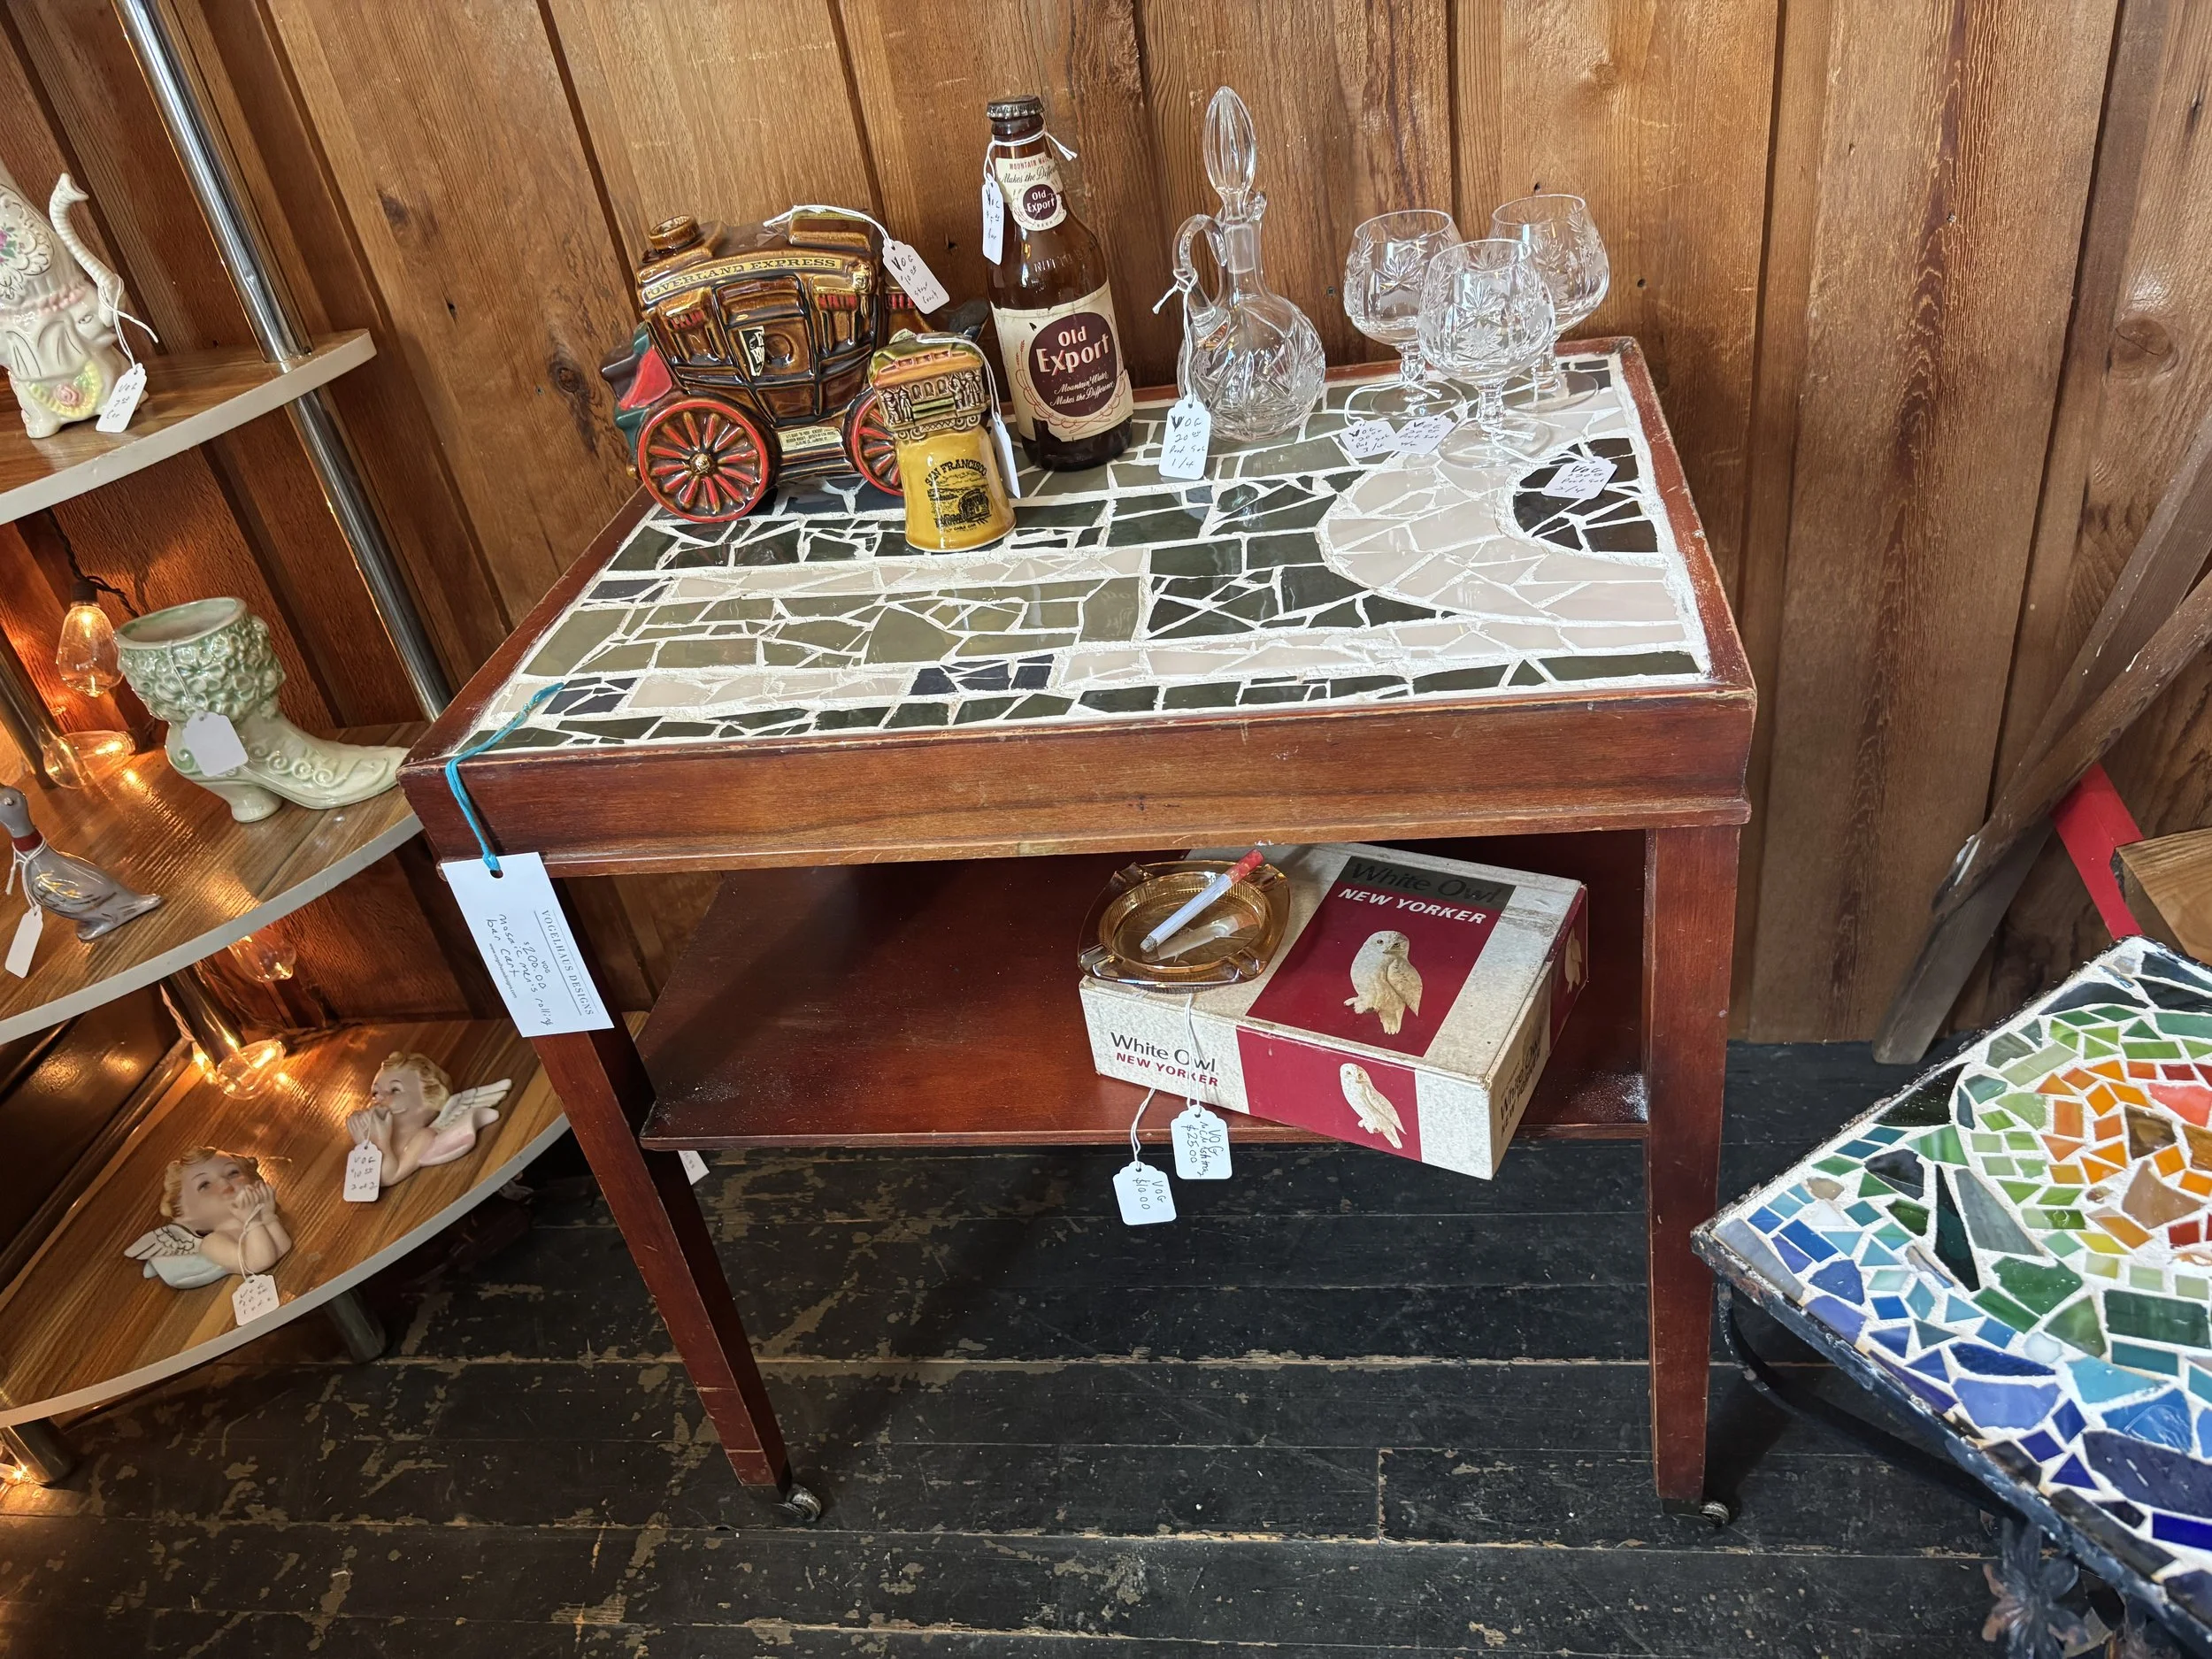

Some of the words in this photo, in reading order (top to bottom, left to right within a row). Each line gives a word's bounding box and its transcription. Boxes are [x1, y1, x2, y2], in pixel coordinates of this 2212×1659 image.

[1009, 160, 1037, 170] MOUNTAIN
[1001, 173, 1023, 183] Makes
[1024, 173, 1036, 182] the
[1026, 197, 1055, 213] Export
[1031, 189, 1047, 201] Old
[891, 255, 914, 271] VOG
[650, 265, 744, 296] OVERLAND
[749, 258, 836, 271] EXPRESS
[1057, 326, 1087, 348] Old
[1035, 334, 1110, 376] Export
[1054, 379, 1091, 395] Mountain
[1049, 396, 1075, 406] Makes
[1076, 393, 1086, 402] the
[1171, 415, 1202, 432] VOG
[925, 467, 941, 487] SAN
[940, 458, 988, 477] FRANCISCO
[1352, 863, 1432, 891] White
[1438, 879, 1502, 903] Owl
[1338, 888, 1393, 906] NEW
[1395, 898, 1487, 925] YORKER
[541, 910, 573, 972] VOGELHAUS
[568, 974, 595, 1016] DESIGNS
[1110, 1032, 1169, 1060] White
[1173, 1048, 1216, 1072] Owl
[1116, 1052, 1150, 1069] NEW
[1156, 1063, 1218, 1087] YORKER
[1207, 1129, 1225, 1156] VOG
[1151, 1180, 1167, 1202] VOG
